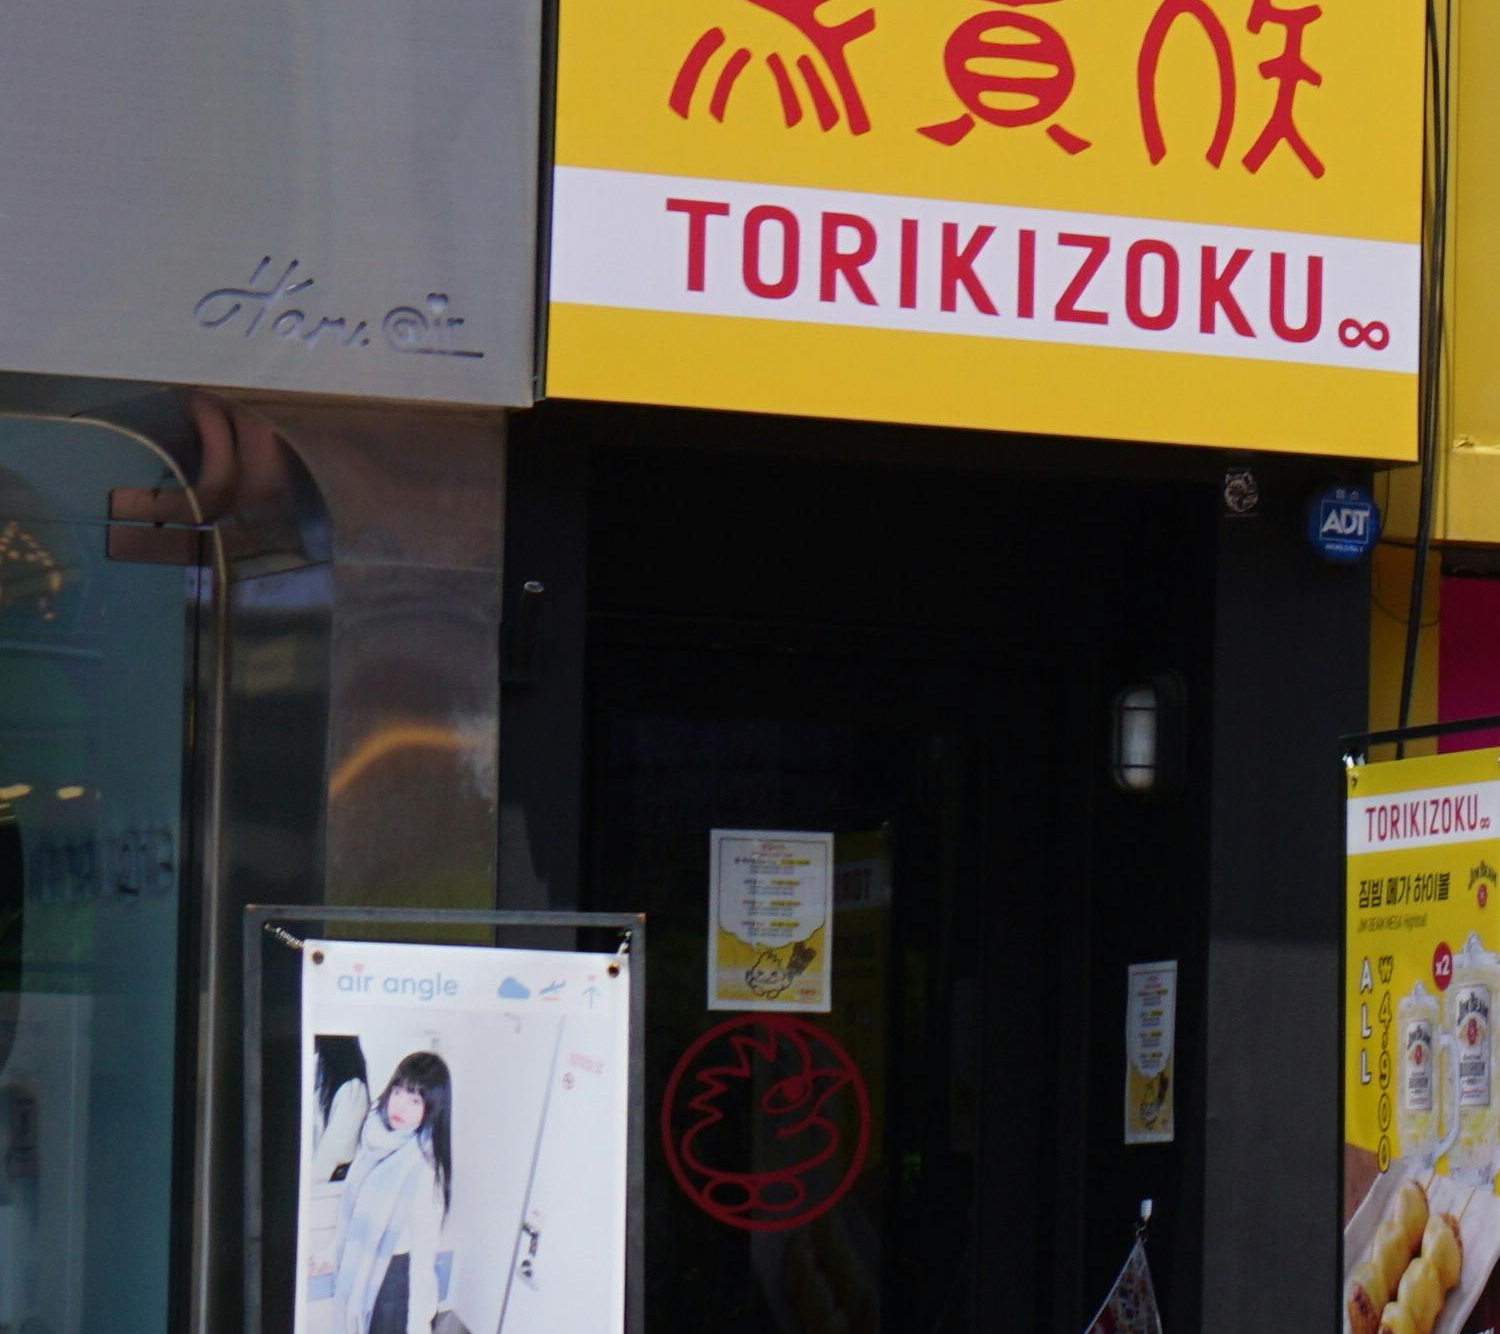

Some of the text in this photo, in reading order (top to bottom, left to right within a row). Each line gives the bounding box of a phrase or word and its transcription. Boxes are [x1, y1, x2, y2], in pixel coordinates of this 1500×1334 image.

[665, 197, 1325, 344] TORIKIZOKU
[1321, 508, 1370, 536] ADT
[1365, 794, 1478, 843] TORIKIZOKU
[1359, 878, 1384, 909] 짐빔
[1414, 871, 1450, 902] 하이볼
[1435, 954, 1450, 975] x2
[337, 965, 460, 1002] air angle
